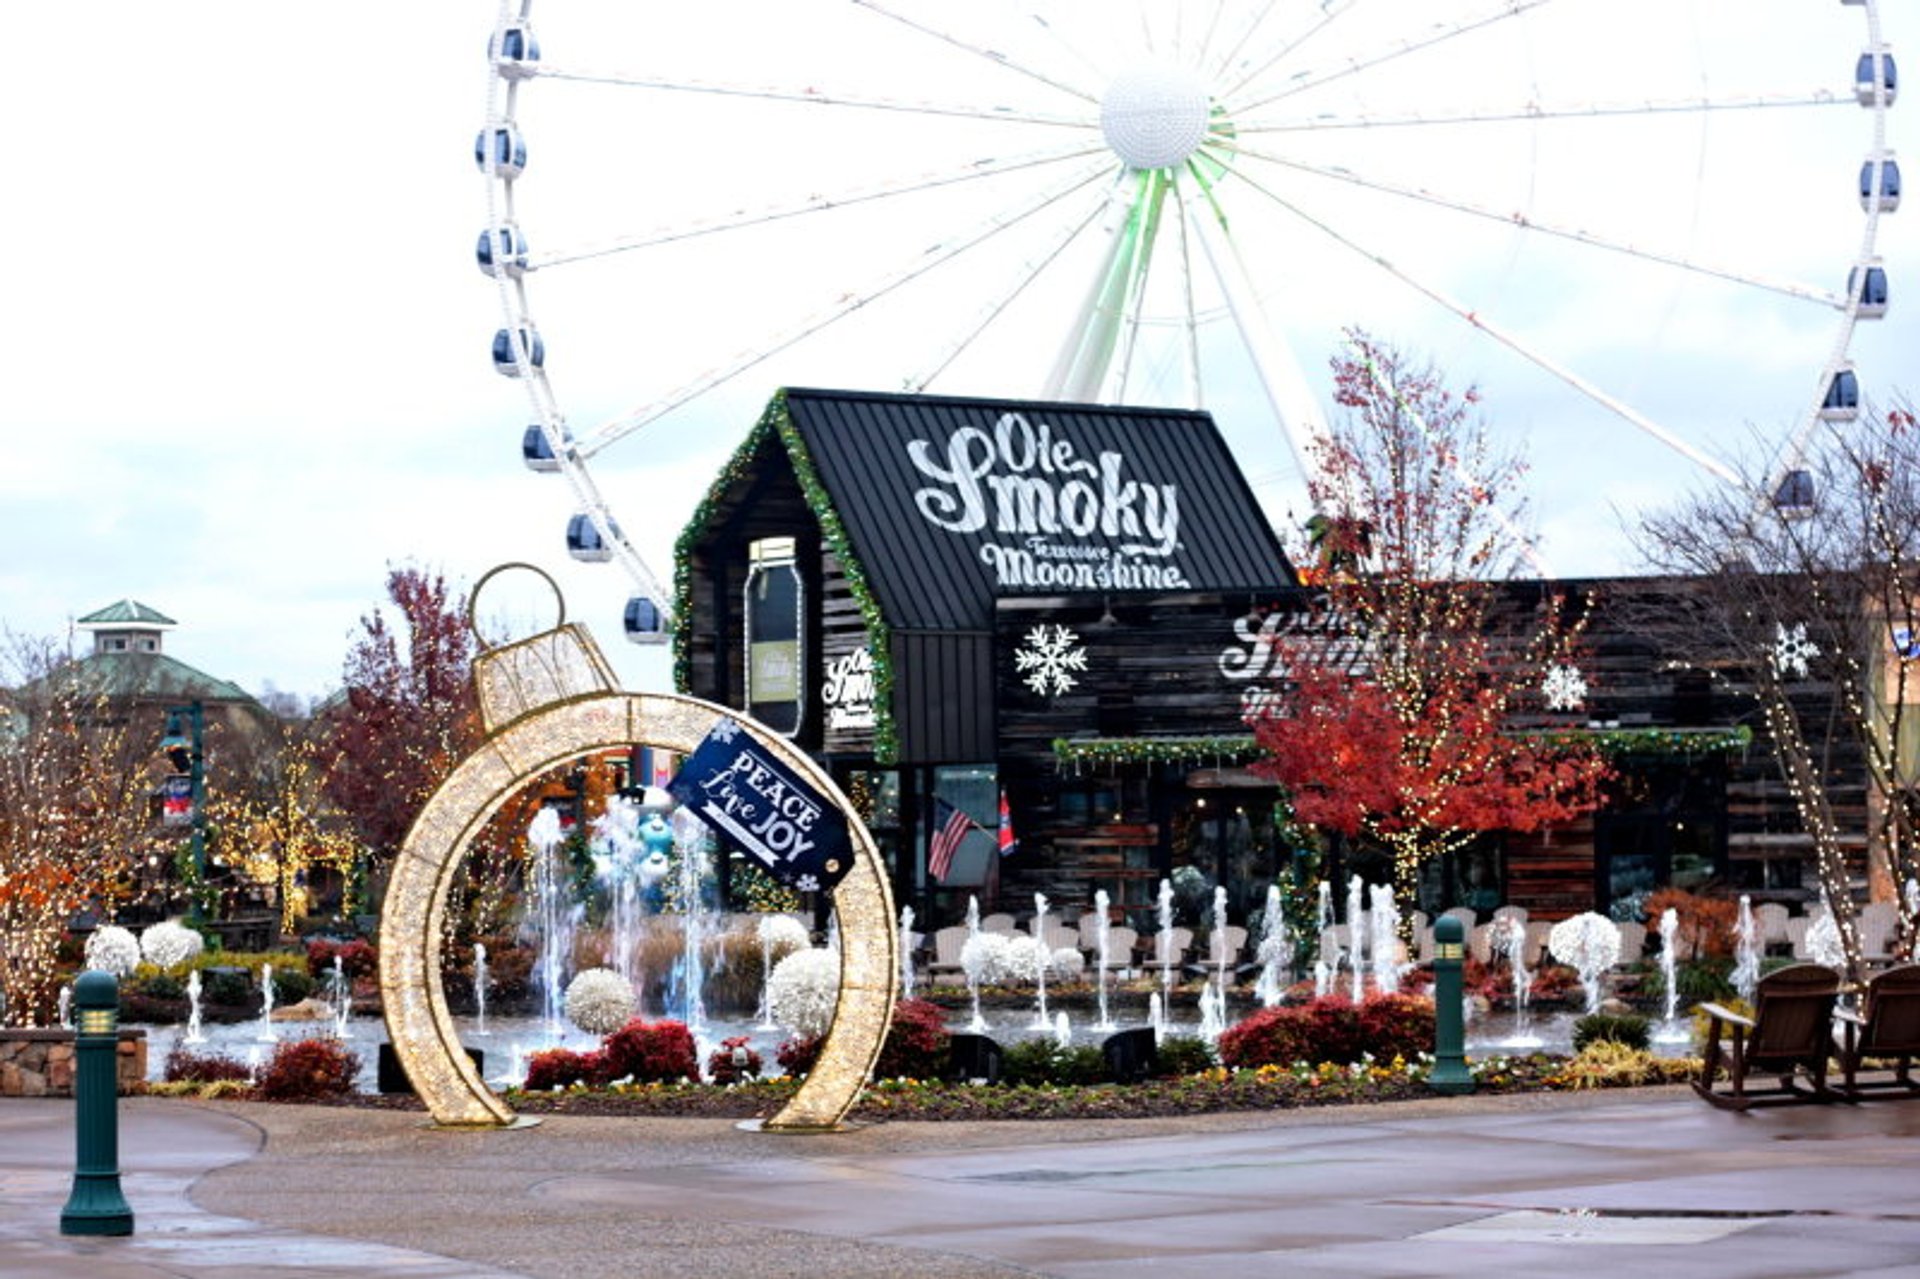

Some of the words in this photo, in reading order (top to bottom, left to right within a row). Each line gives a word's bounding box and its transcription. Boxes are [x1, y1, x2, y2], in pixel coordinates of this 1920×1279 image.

[995, 412, 1098, 478] Ole
[906, 426, 1184, 556] Smoky
[980, 542, 1191, 589] Moonshine
[699, 768, 757, 819] Love
[730, 751, 821, 832] PEACE
[750, 811, 815, 863] JOY
